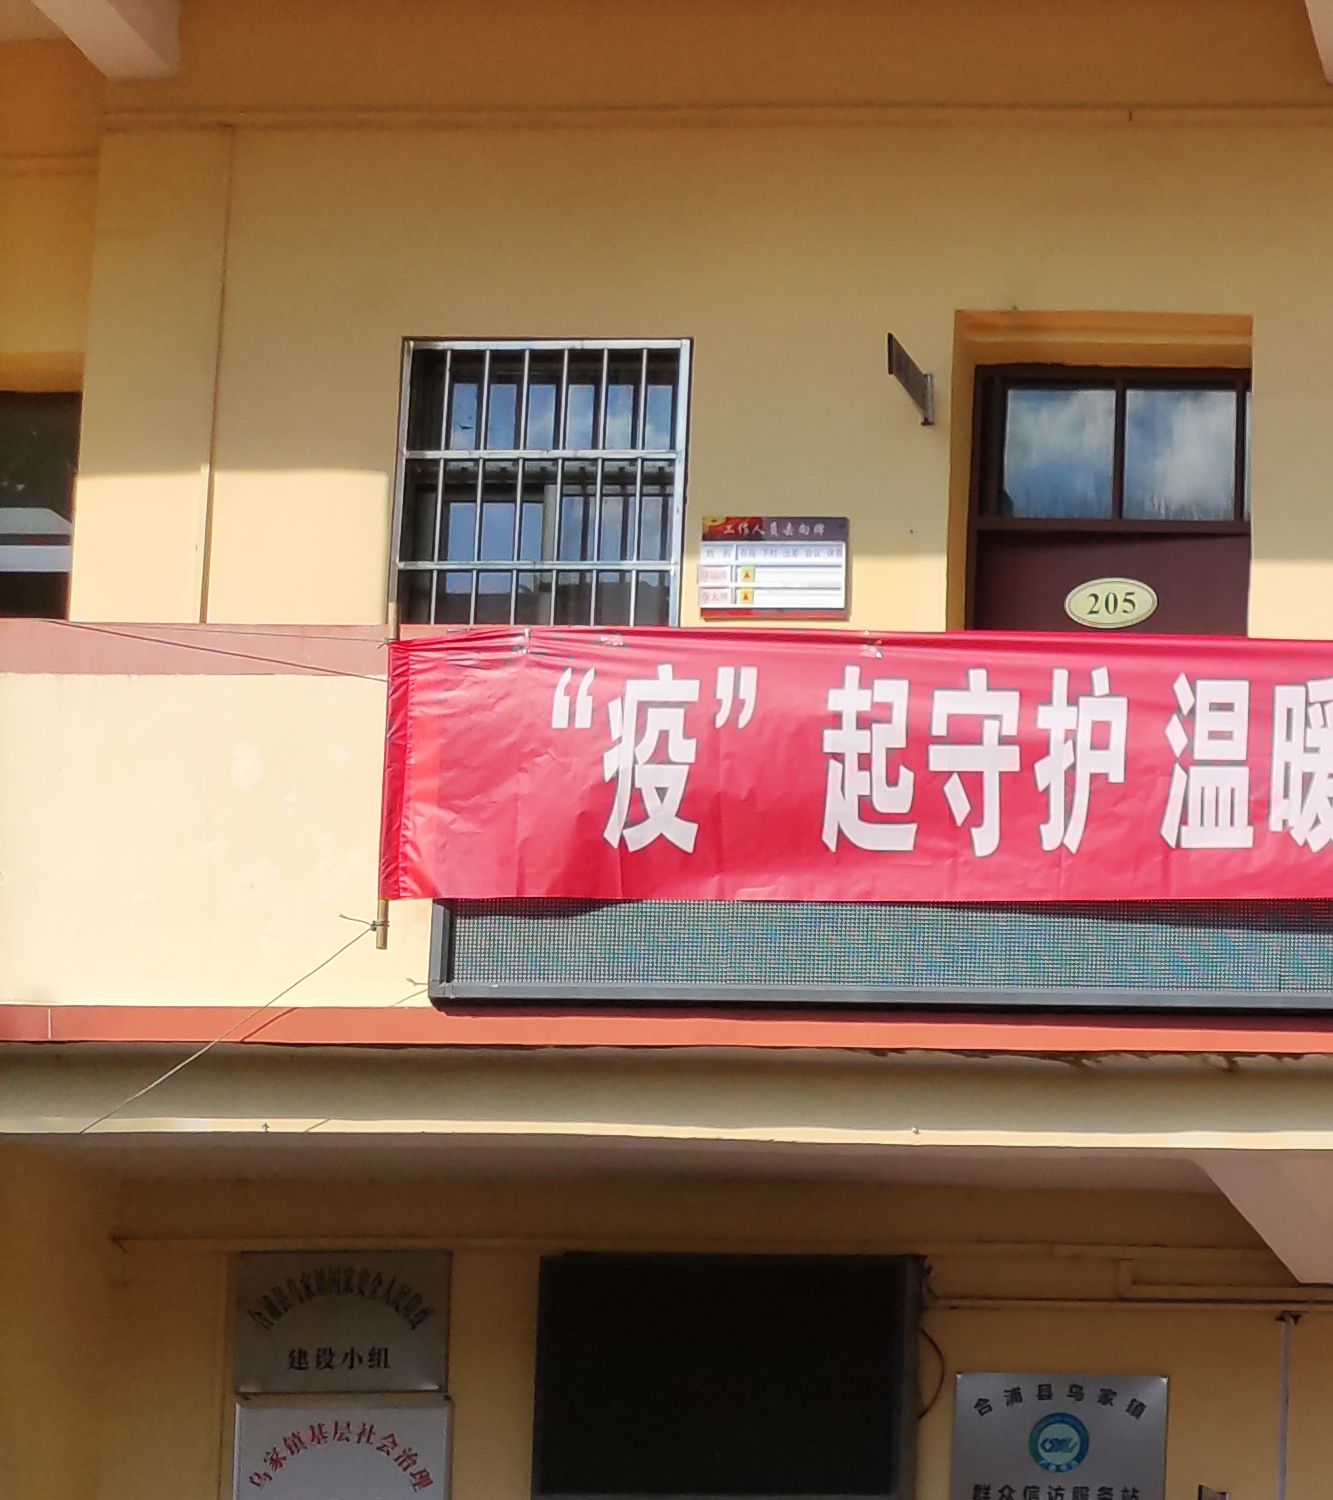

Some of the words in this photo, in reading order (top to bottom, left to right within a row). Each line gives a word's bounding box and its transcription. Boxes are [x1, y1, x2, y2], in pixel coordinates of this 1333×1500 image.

[1086, 591, 1136, 615] 205
[287, 1346, 391, 1371] 建设小组
[972, 1382, 1148, 1420] 合浦县乌家镇
[248, 1419, 435, 1493] 乌家镇基层社会治理
